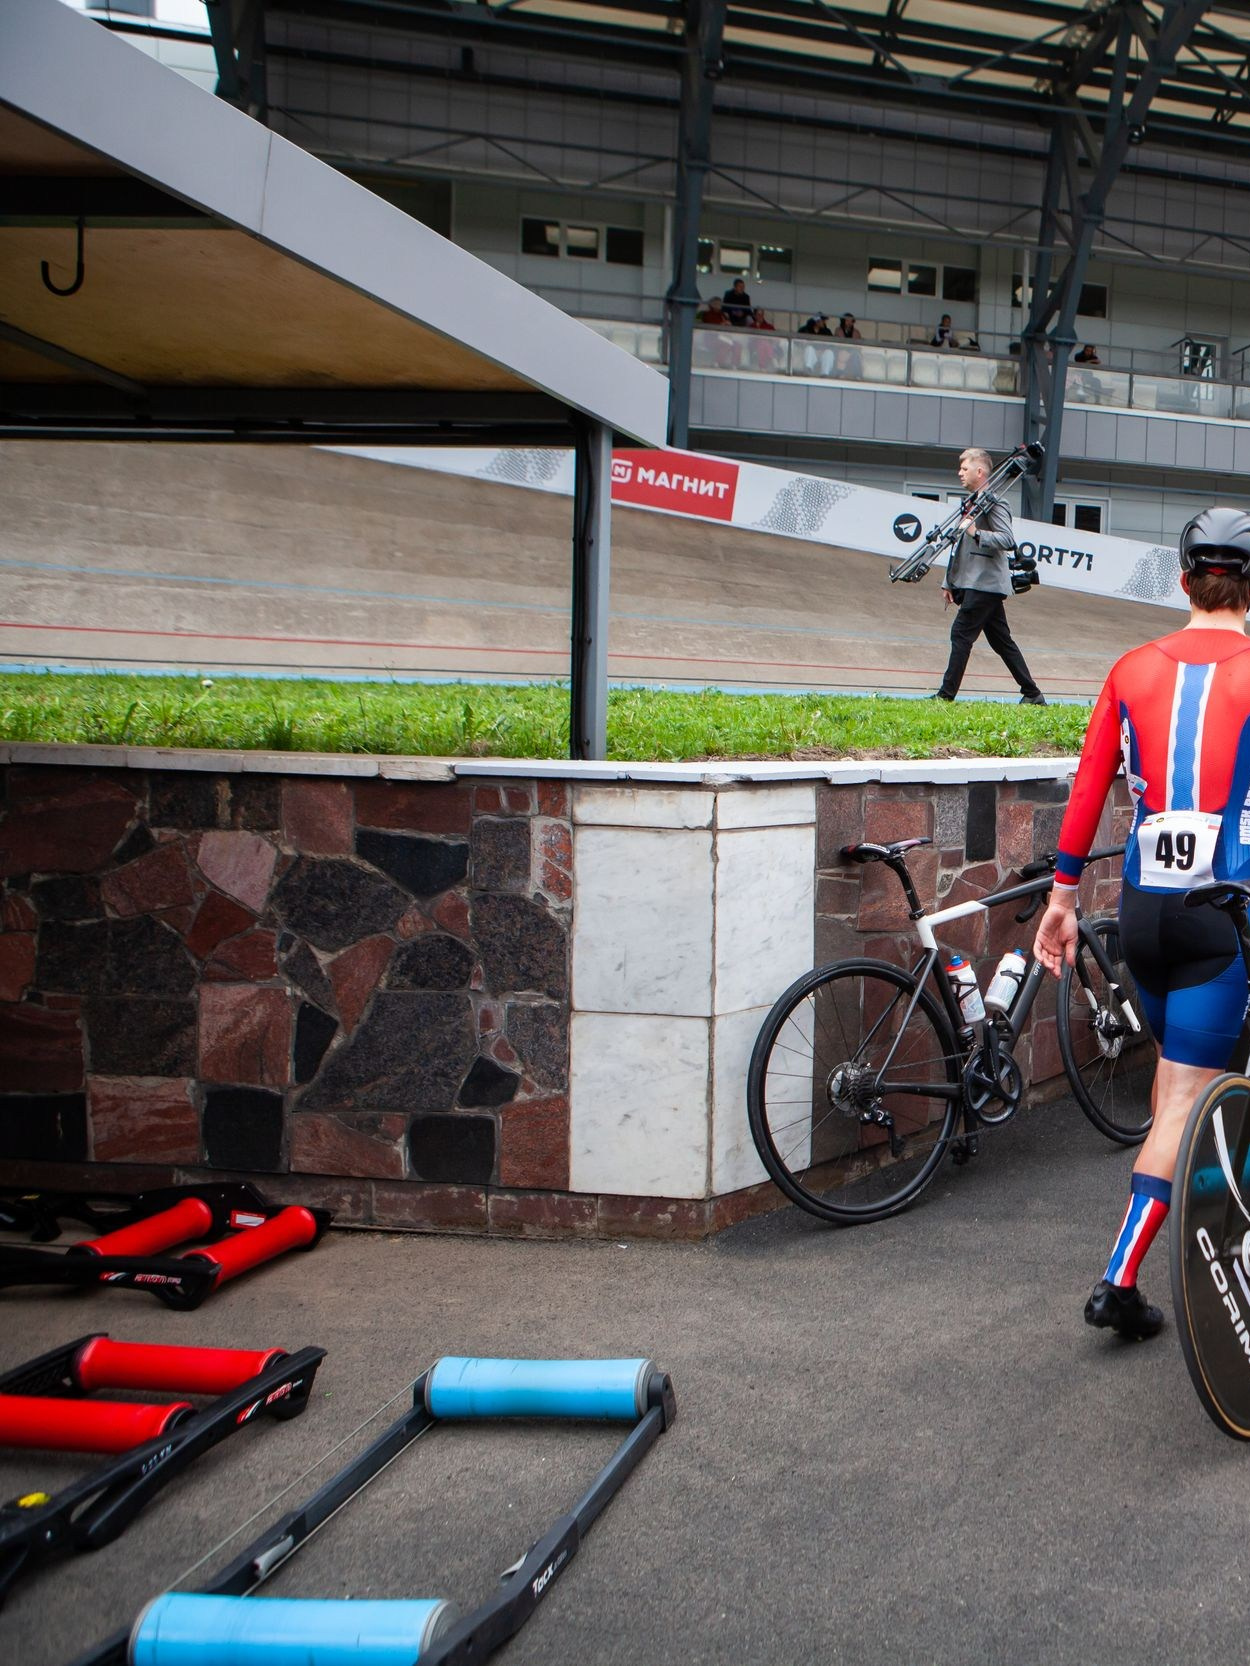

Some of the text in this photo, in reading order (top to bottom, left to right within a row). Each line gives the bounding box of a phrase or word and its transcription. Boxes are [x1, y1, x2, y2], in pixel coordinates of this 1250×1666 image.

[637, 466, 729, 499] МАГНИТ
[1154, 829, 1196, 871] 49
[532, 1561, 554, 1599] Tacx
